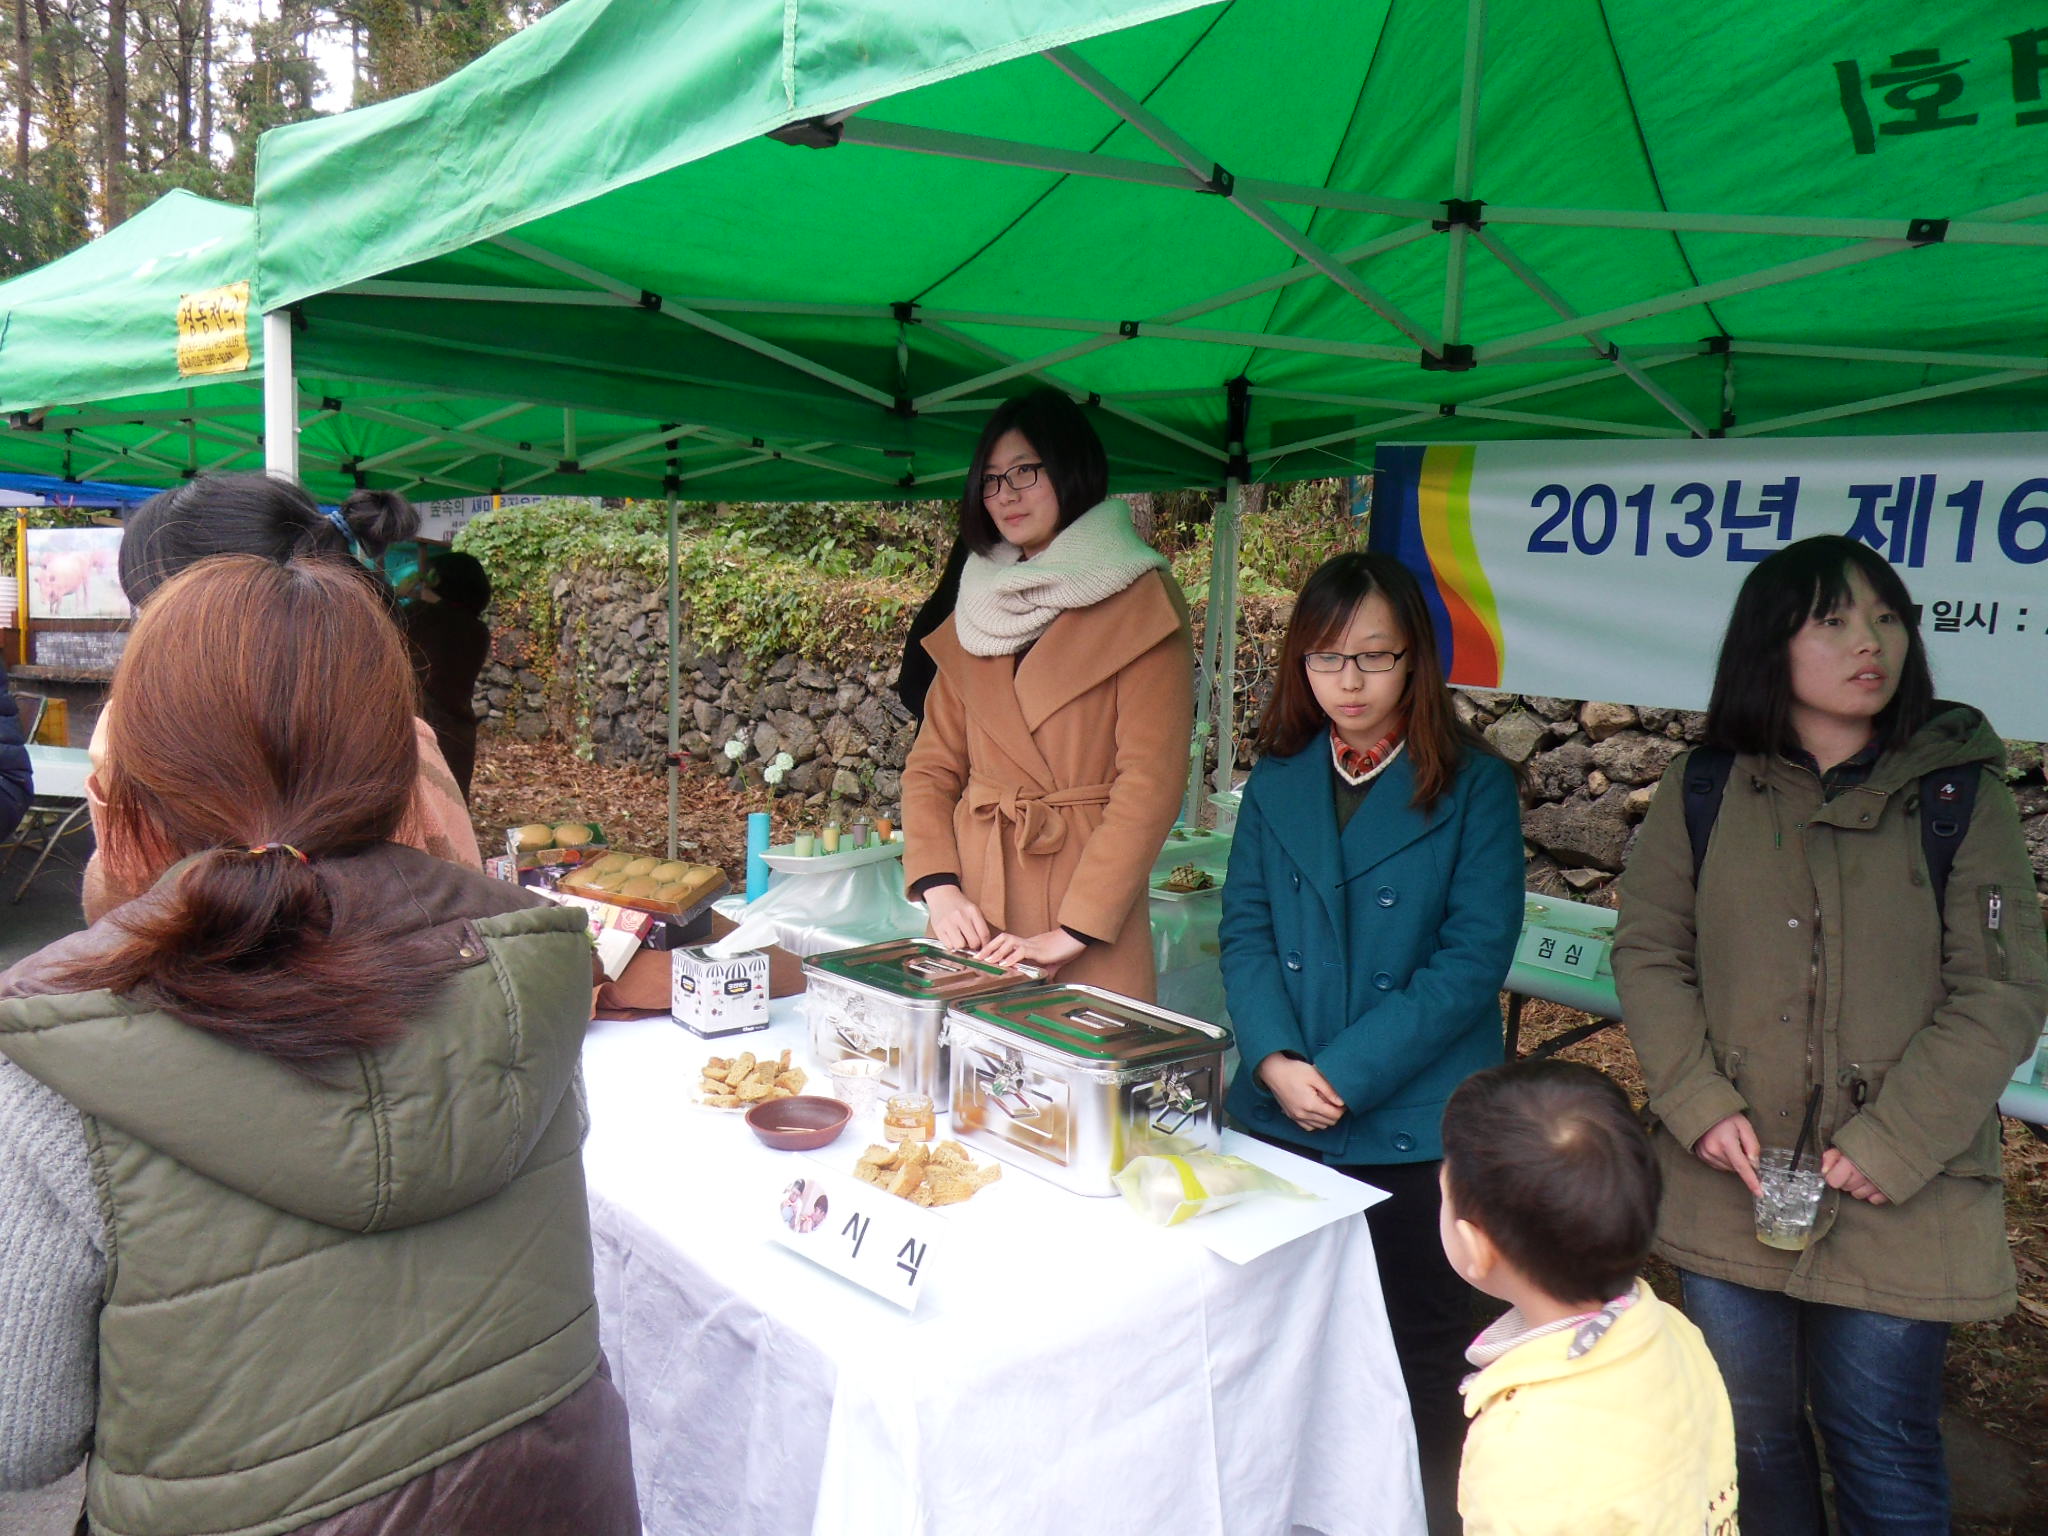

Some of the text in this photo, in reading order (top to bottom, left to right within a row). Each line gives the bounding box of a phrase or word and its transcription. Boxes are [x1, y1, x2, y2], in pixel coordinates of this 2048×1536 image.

[1527, 473, 2048, 569] 2013년 제16
[1932, 600, 1999, 635] 일시
